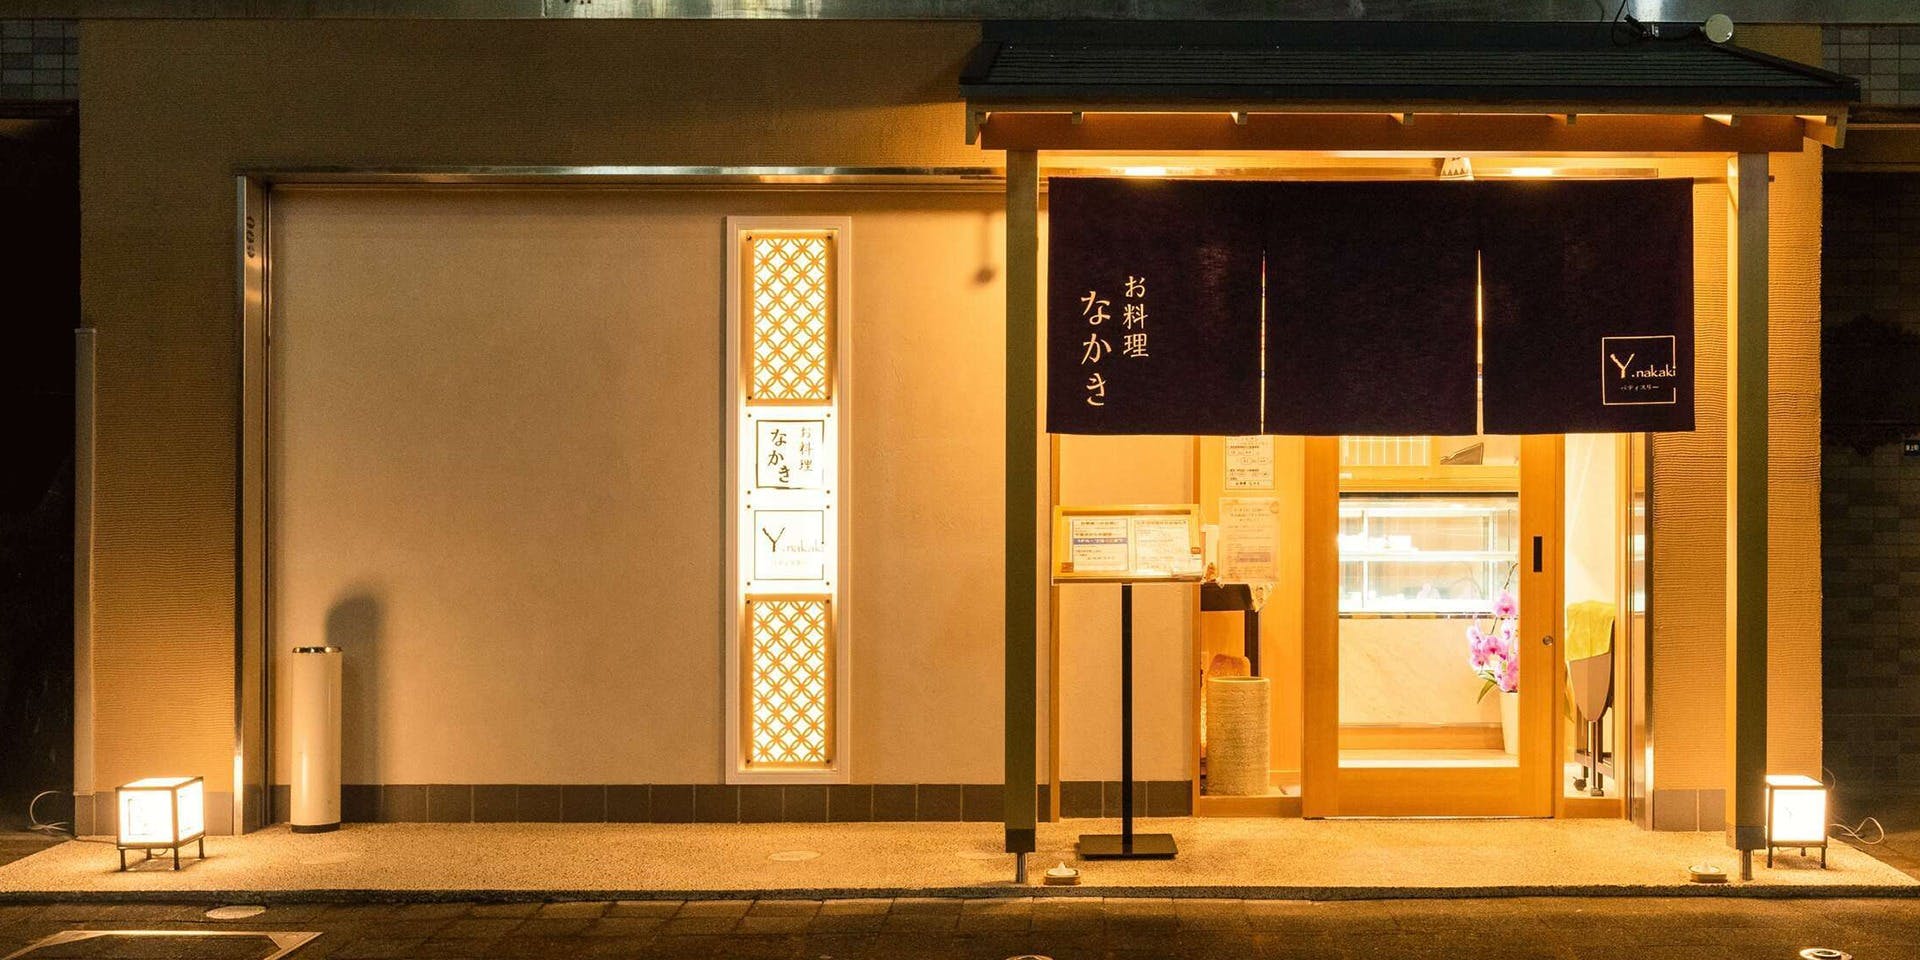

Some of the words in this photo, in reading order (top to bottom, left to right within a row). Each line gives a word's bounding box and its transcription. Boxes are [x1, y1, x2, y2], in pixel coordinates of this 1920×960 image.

[1122, 275, 1149, 358] お料理
[1080, 290, 1112, 406] なかき
[1609, 353, 1676, 379] Y.nakaki
[768, 429, 791, 483] なかき
[798, 426, 813, 472] お料理
